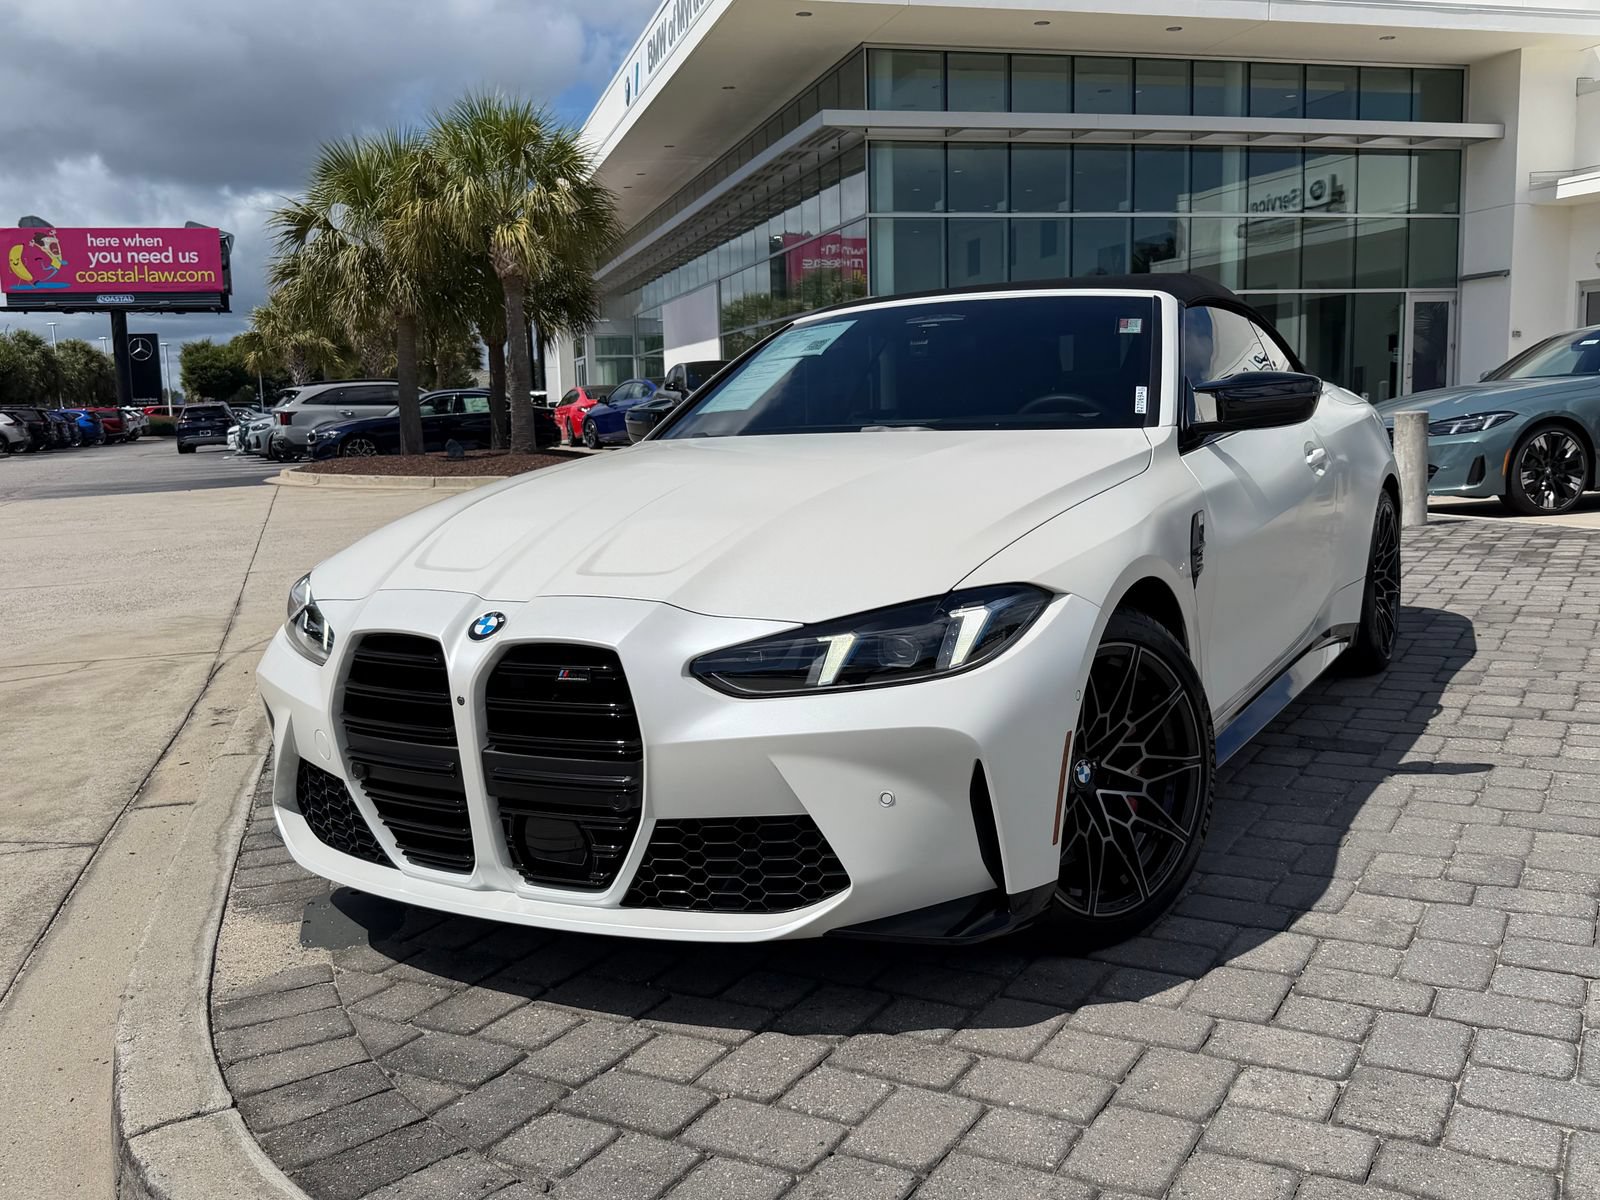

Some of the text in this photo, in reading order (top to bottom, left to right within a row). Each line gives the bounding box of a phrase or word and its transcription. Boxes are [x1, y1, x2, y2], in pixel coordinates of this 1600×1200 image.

[647, 17, 666, 75] BMW
[668, 4, 677, 48] of
[86, 233, 163, 247] here when
[88, 246, 199, 268] you need us
[75, 265, 216, 283] coastal-law.com
[1203, 724, 1217, 832] MICHELIN
